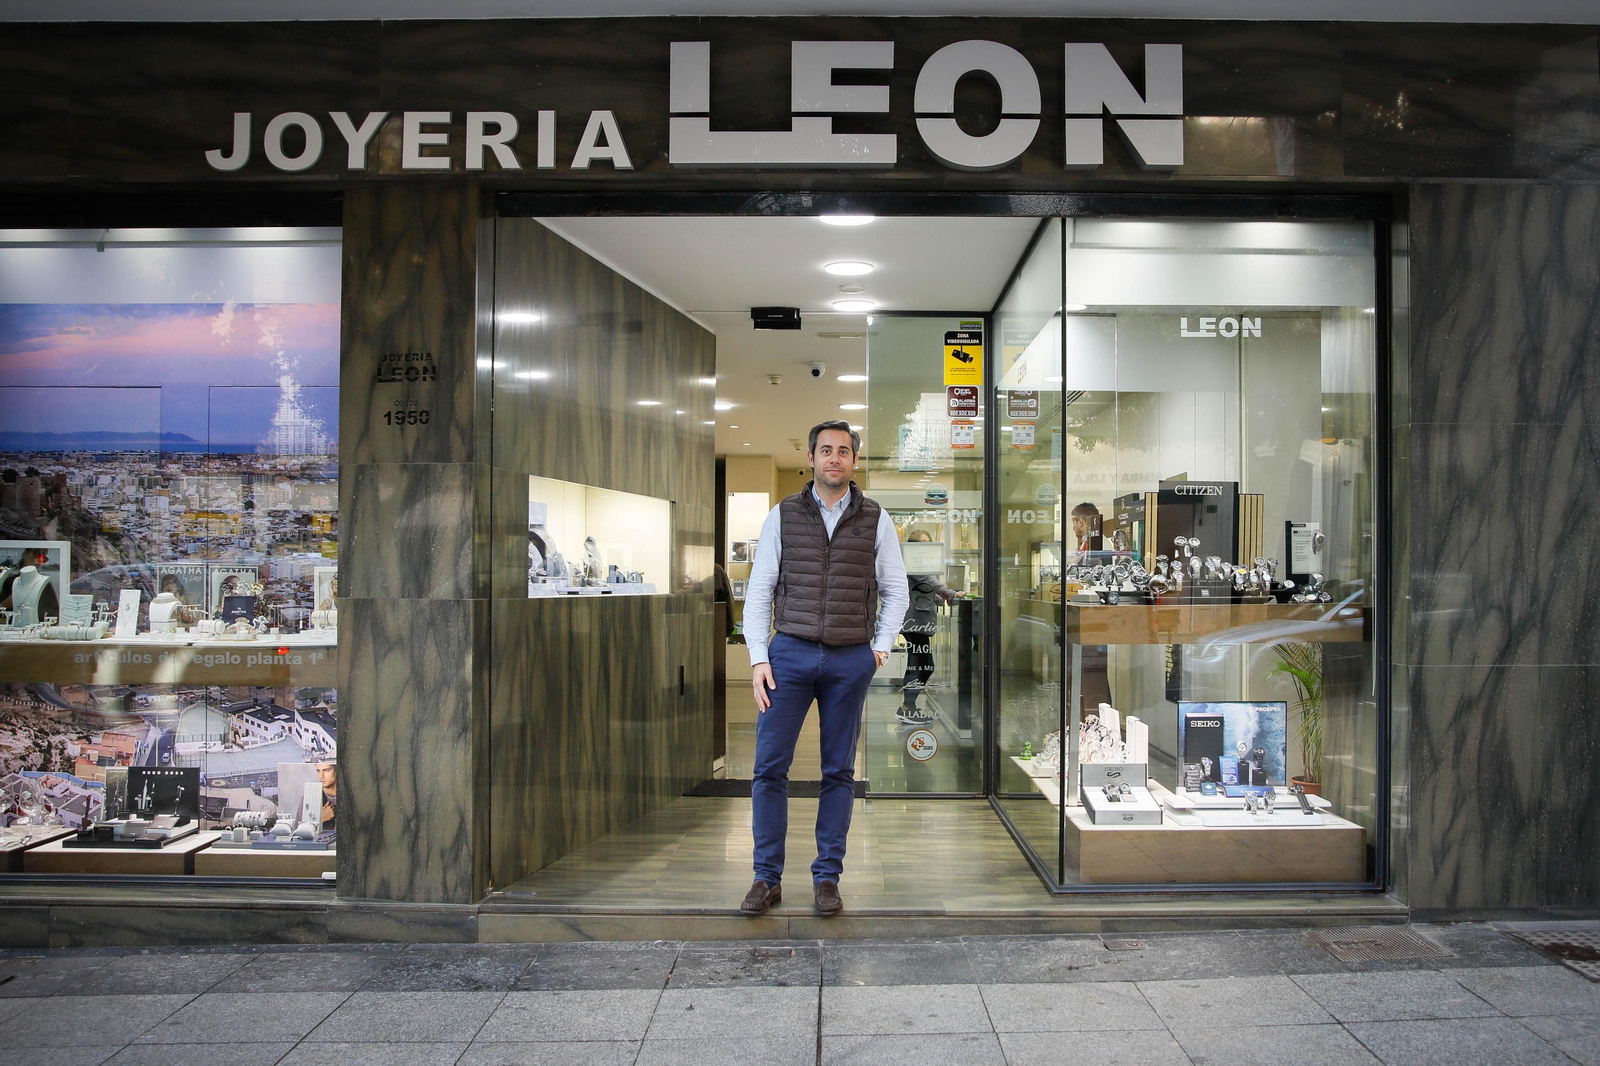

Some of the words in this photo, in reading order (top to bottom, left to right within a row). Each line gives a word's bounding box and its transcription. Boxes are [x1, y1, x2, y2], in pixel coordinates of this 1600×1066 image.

[204, 109, 634, 171] JOYERIA
[669, 39, 1184, 168] LEON
[1180, 317, 1262, 338] LEON
[381, 353, 433, 362] JOYERIA
[376, 366, 437, 383] LEON
[383, 410, 430, 426] 1950
[1174, 485, 1223, 496] CITIZEN
[922, 510, 977, 524] LEON
[161, 566, 203, 575] AGATHA
[901, 618, 946, 633] Cartier
[247, 651, 303, 667] planta
[309, 651, 324, 666] 1ª
[1190, 720, 1221, 728] SEIKO
